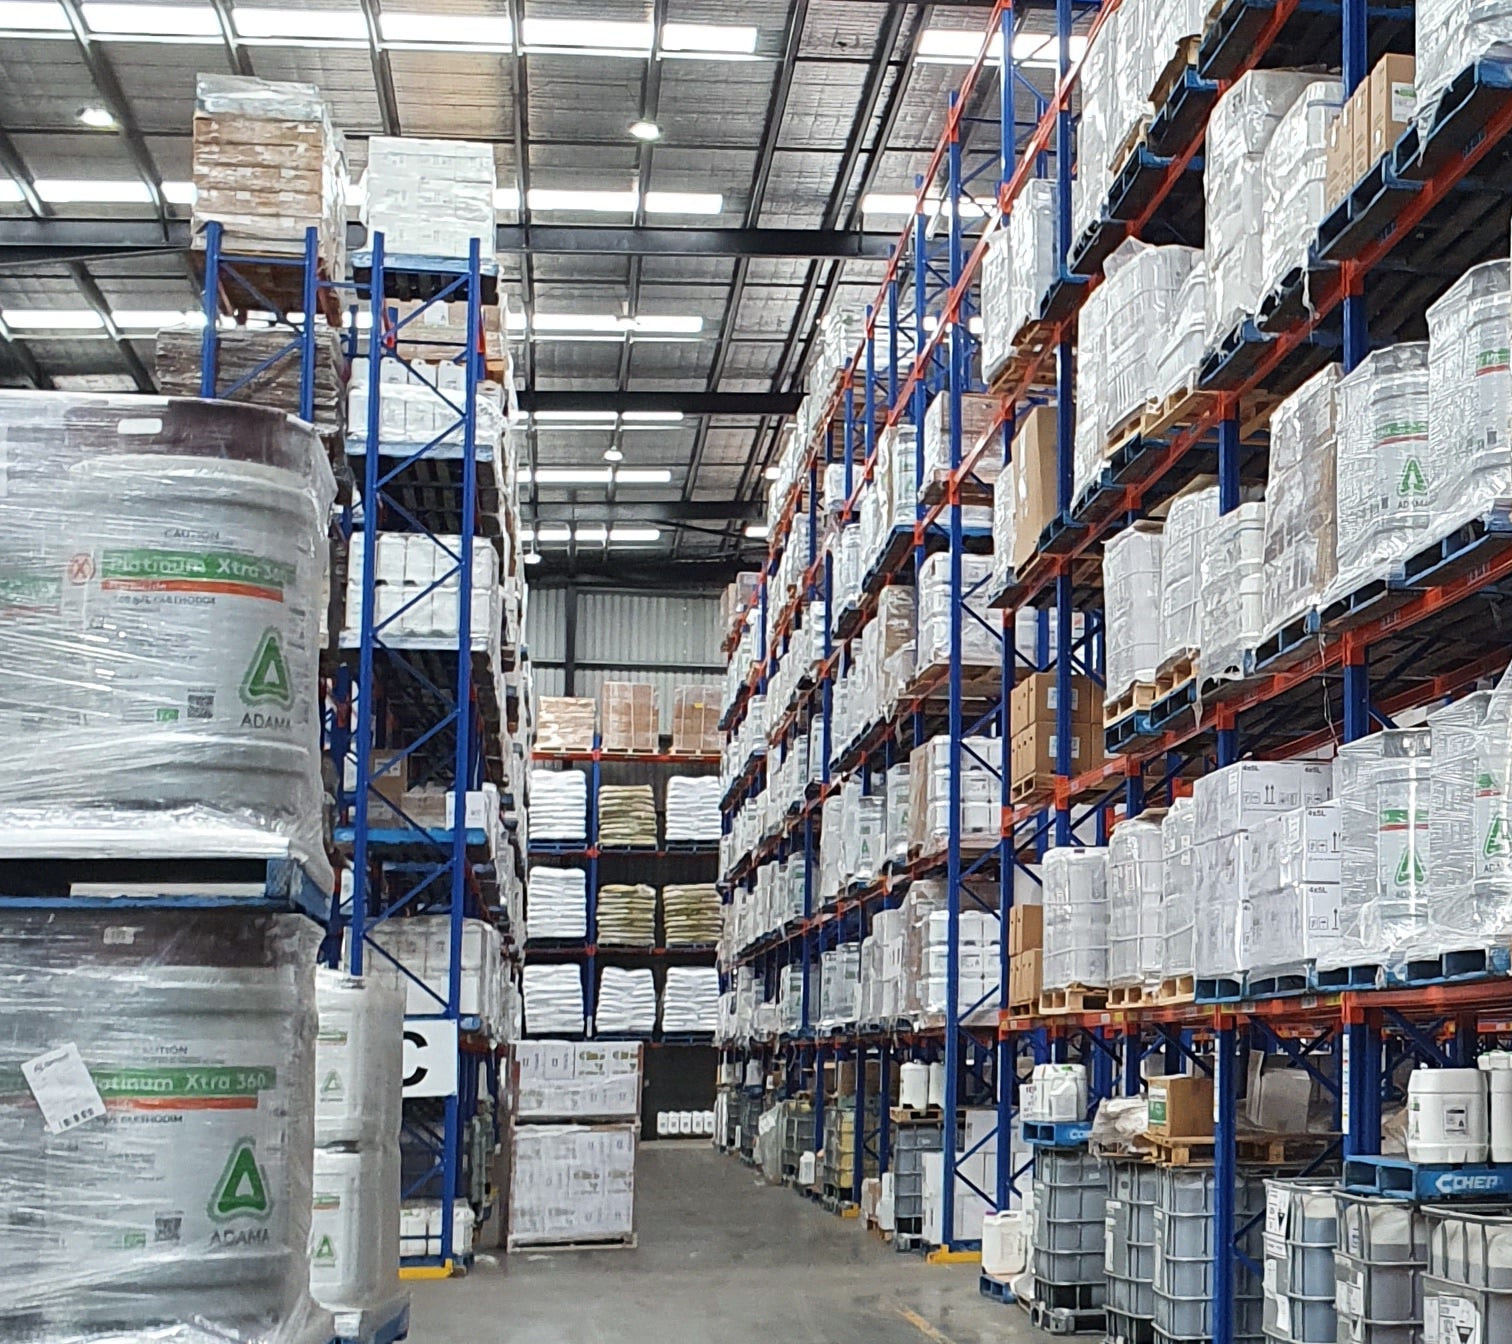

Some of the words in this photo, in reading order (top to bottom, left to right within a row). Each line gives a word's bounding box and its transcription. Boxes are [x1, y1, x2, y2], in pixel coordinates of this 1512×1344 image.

[217, 558, 259, 576] Xtra
[185, 1074, 230, 1090] Xtra
[236, 1073, 265, 1089] 360
[210, 1227, 270, 1246] ADAMA
